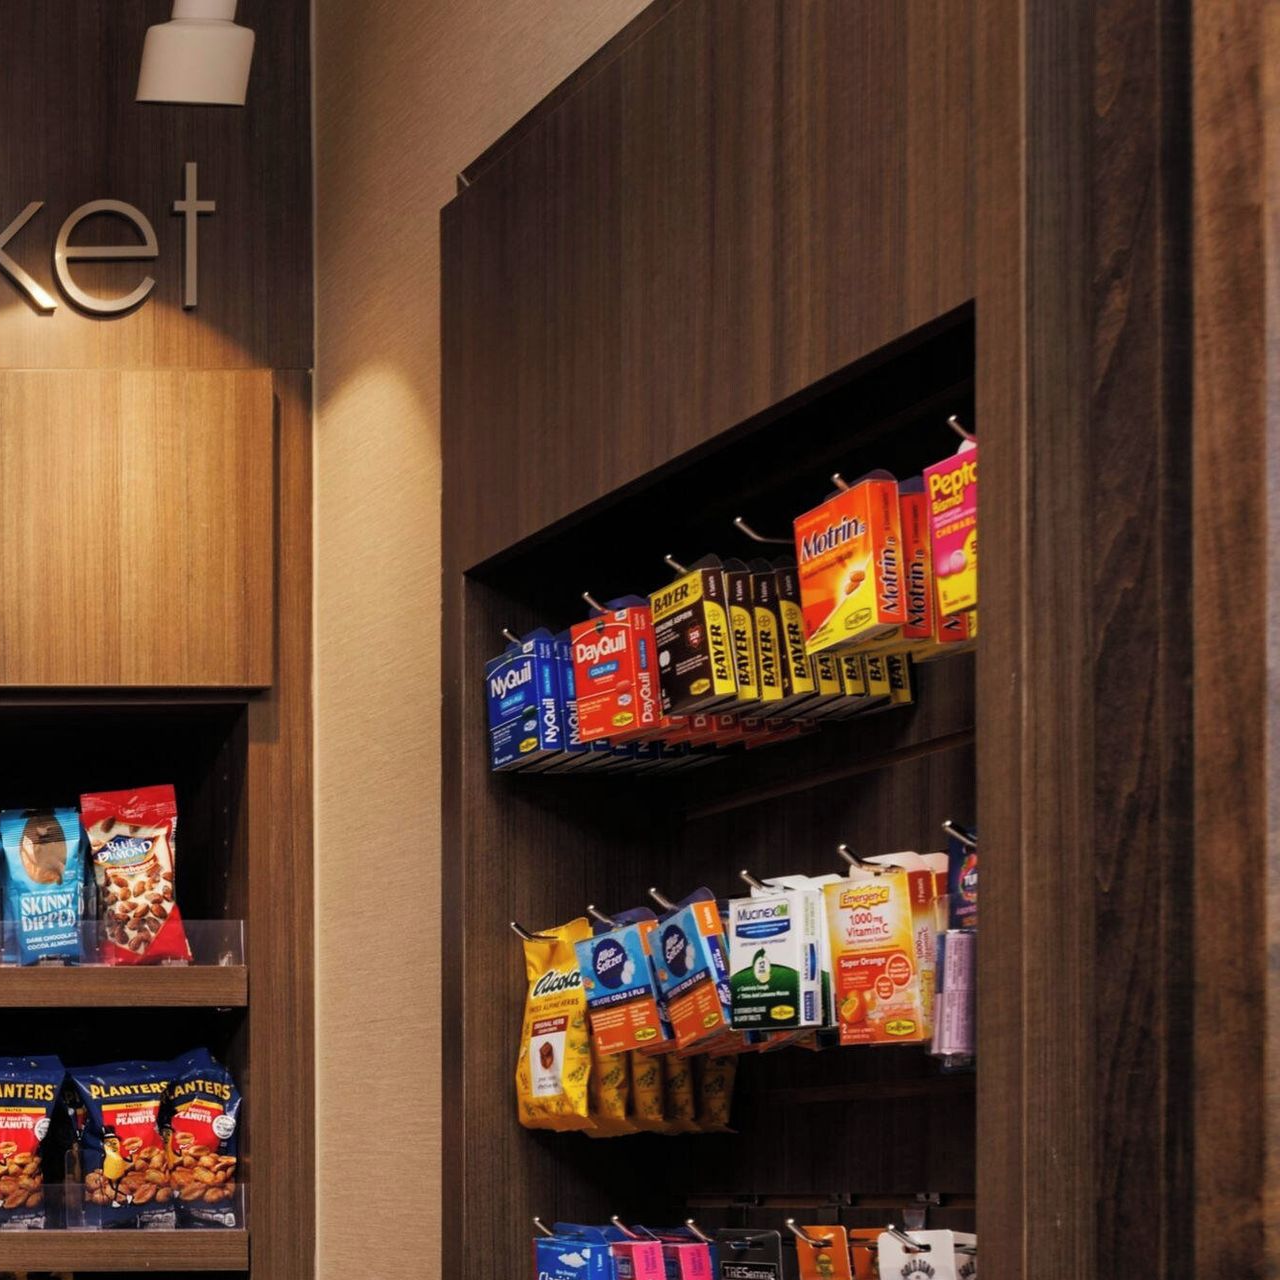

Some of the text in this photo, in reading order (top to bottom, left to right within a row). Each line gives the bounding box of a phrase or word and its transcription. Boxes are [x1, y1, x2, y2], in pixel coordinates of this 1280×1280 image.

[932, 491, 965, 515] Bismol
[800, 515, 860, 564] Motrin
[879, 544, 899, 615] Motrin
[653, 583, 689, 614] BAYER
[908, 559, 926, 631] Motrin
[576, 630, 627, 664] DayQuil
[710, 623, 728, 681] BAYER
[737, 629, 751, 687] BAYER
[760, 629, 776, 687] BAYER
[788, 622, 807, 679] BAYER
[490, 661, 532, 699] NyQuil
[638, 672, 654, 723] DayQuil
[542, 698, 559, 743] NyQuil
[97, 841, 152, 862] DIAMOND
[106, 840, 136, 853] BLUE
[21, 892, 75, 916] SKINNY
[842, 889, 889, 906] Emergen-C
[22, 914, 76, 932] DIPPED
[846, 925, 878, 937] Vitamin
[50, 940, 78, 949] ALMONDS
[840, 956, 887, 969] Super Orange
[531, 969, 582, 998] Ricola
[611, 994, 627, 1002] COLD
[90, 1081, 169, 1099] PLANTERS
[115, 1114, 156, 1126] PEANUTS
[723, 1265, 776, 1280] TRESemmé
